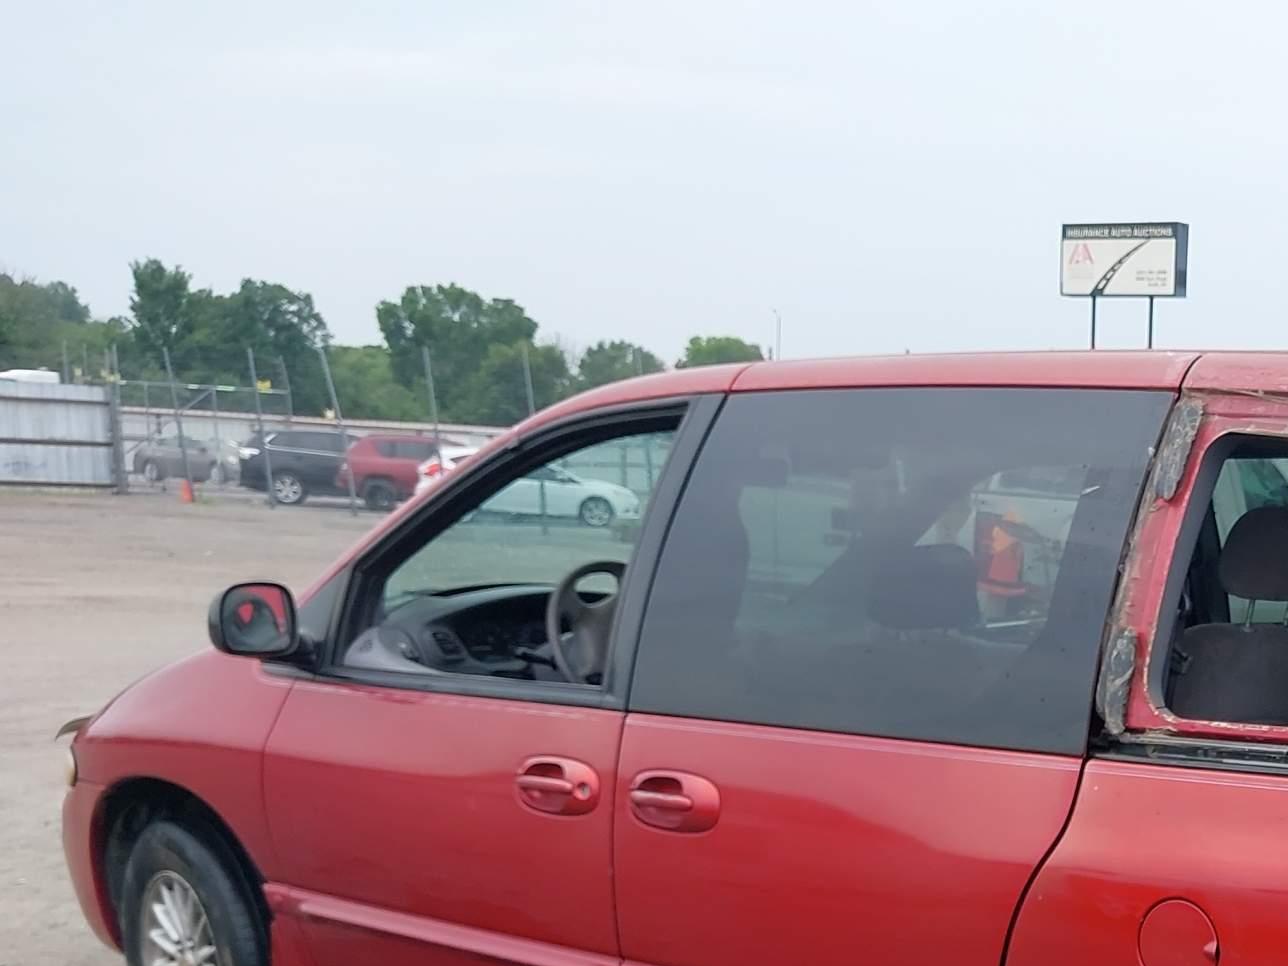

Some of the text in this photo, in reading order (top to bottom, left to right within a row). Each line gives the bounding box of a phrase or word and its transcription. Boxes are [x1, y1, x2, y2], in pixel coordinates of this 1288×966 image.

[1066, 225, 1173, 238] INSURANCE AUTO AUCTIONS
